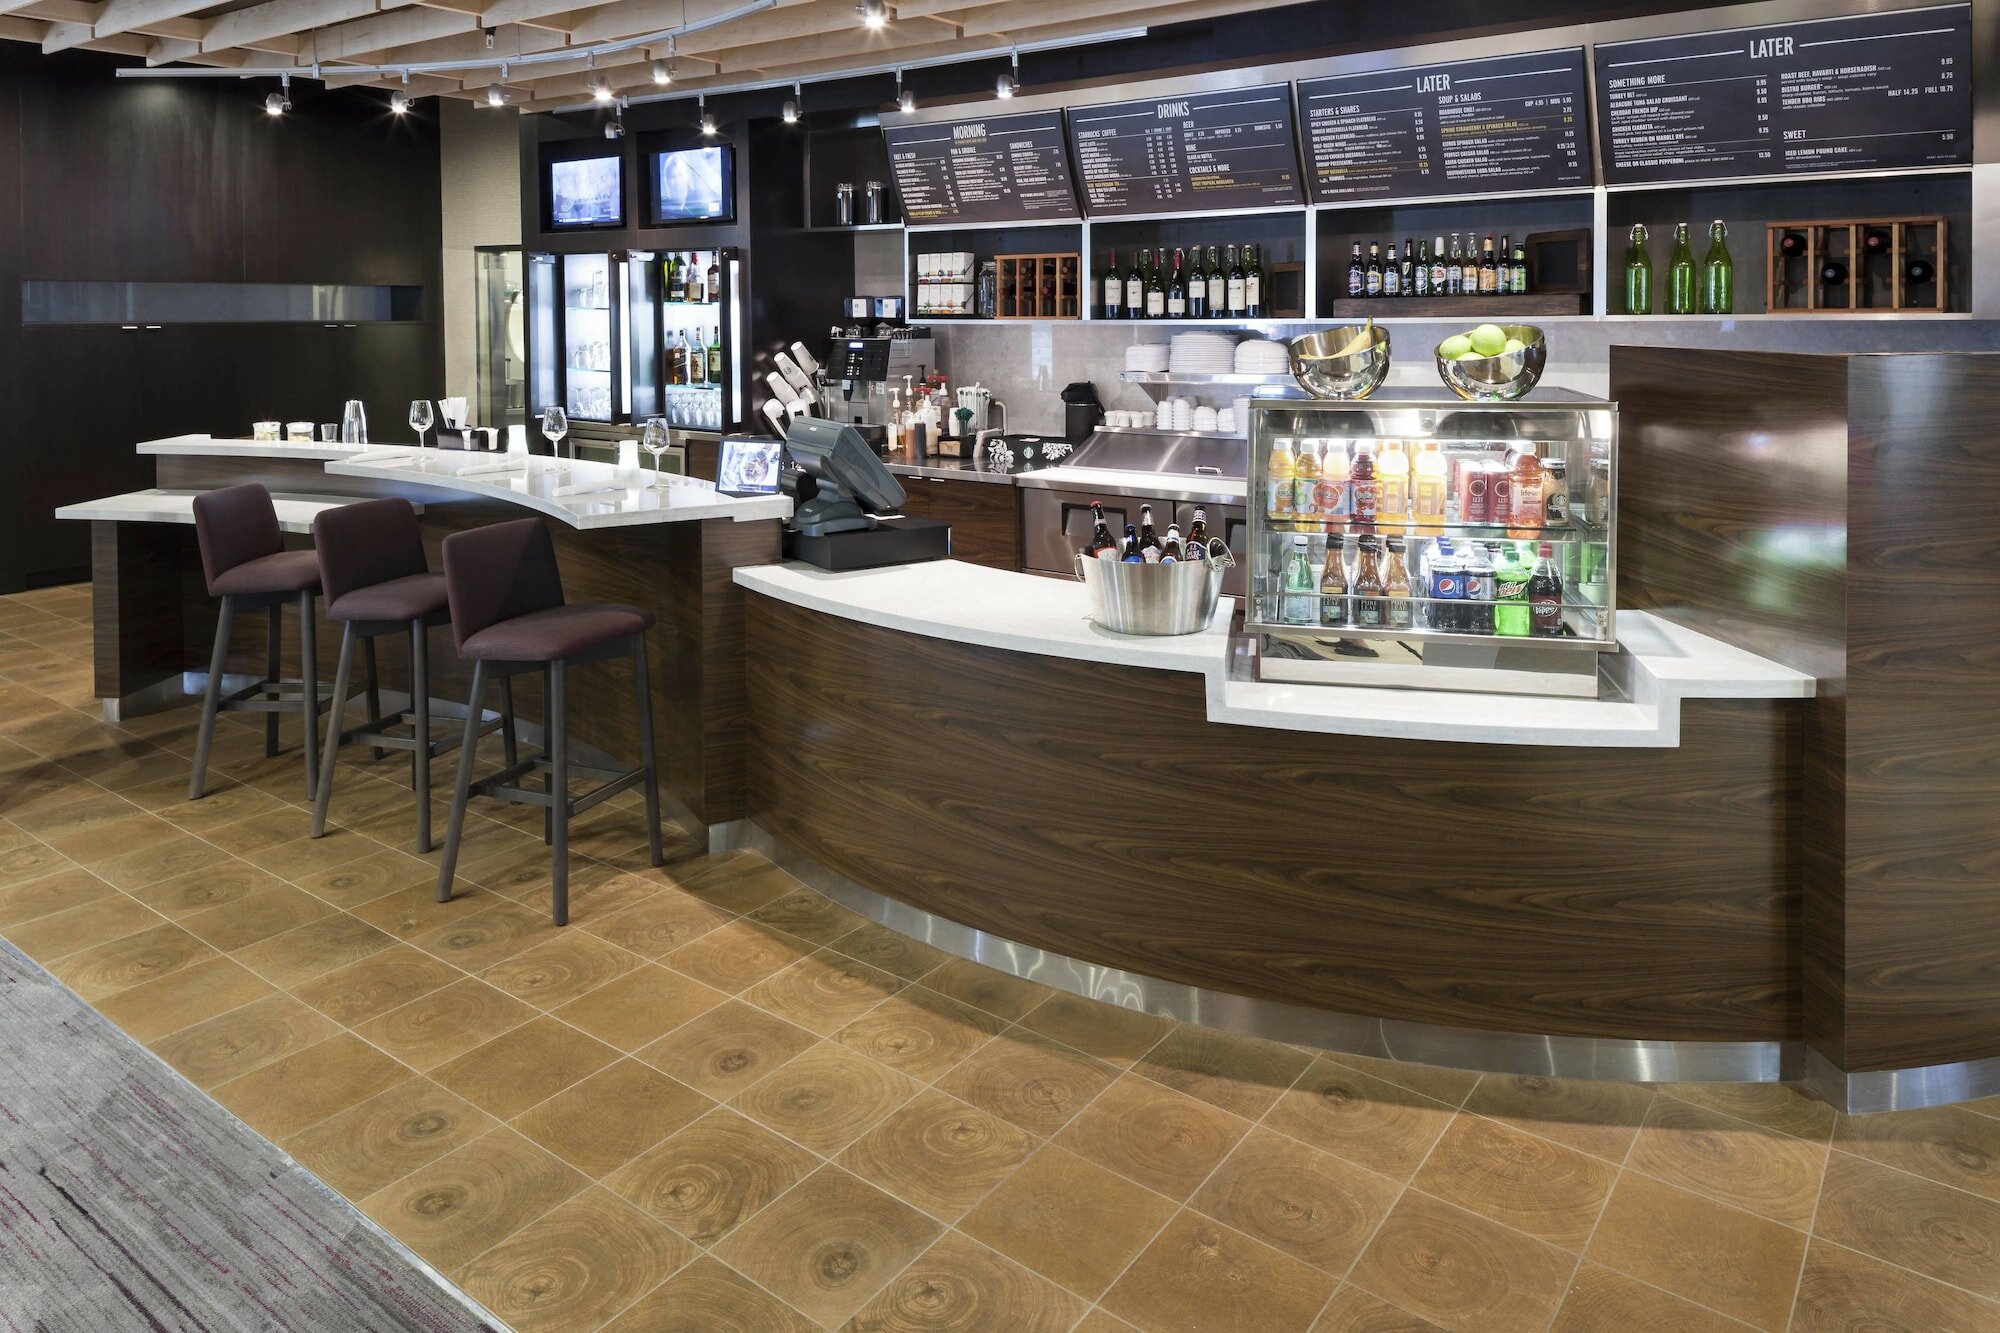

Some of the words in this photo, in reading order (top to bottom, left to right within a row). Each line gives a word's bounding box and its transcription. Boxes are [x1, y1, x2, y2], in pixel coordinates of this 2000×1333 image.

[1749, 36, 1793, 58] LATER
[1812, 68, 1833, 76] HAVARTI
[1839, 64, 1876, 74] HORSERADISH
[1417, 73, 1449, 93] LATER
[1608, 76, 1645, 88] SOMETHING
[1647, 74, 1665, 84] MORE
[1903, 87, 1918, 95] 14.25
[1438, 95, 1452, 103] SOUP
[1454, 94, 1458, 102] &
[1460, 92, 1481, 101] SALADS
[1661, 95, 1687, 103] CROISSANT
[1782, 97, 1800, 105] TENDER
[1158, 101, 1188, 118] DRINKS
[1310, 107, 1333, 117] STARTERS
[1340, 105, 1359, 114] SHARES
[1183, 120, 1193, 128] BEER
[952, 123, 985, 139] MORNING
[1102, 128, 1116, 136] COFFEE
[1783, 129, 1806, 139] SWEET
[1010, 141, 1032, 149] SANDWICHES
[1189, 165, 1211, 173] COCKTAILS
